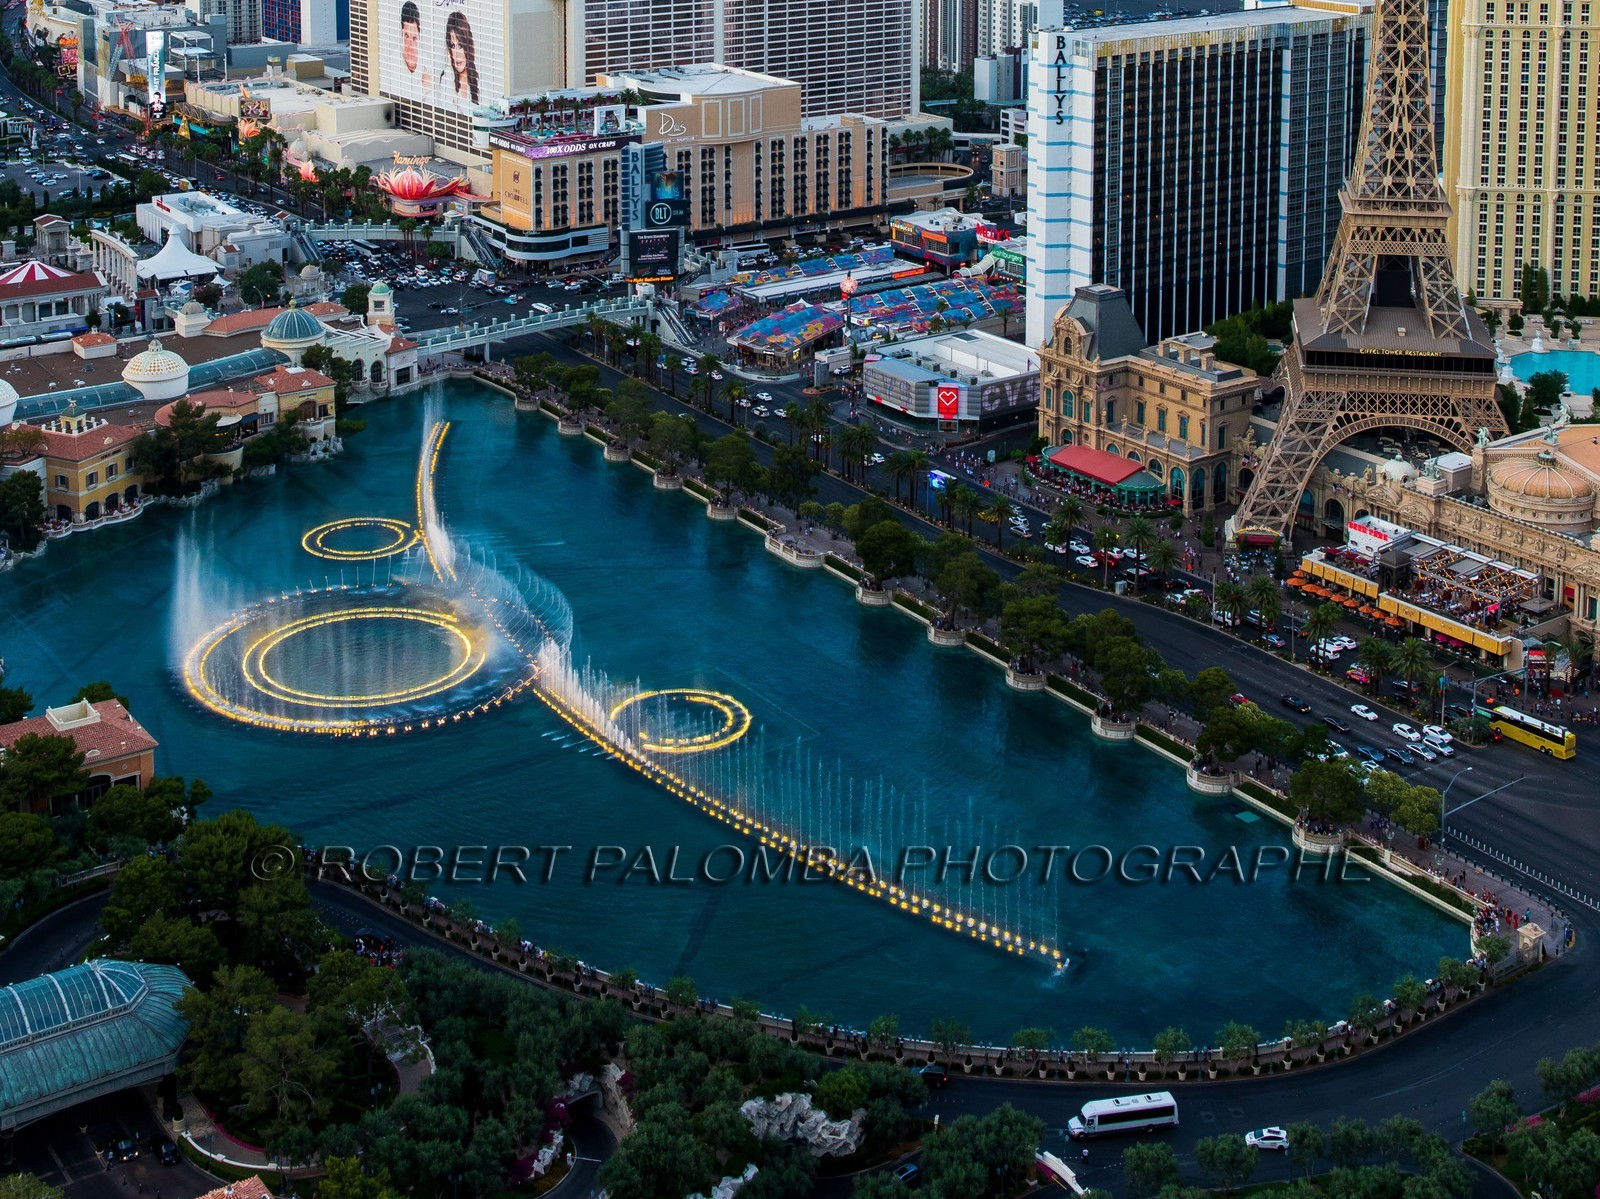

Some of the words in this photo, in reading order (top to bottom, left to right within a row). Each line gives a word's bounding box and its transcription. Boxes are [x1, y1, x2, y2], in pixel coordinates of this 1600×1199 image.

[1054, 36, 1067, 125] BALLYS
[546, 144, 563, 154] 100X
[563, 143, 587, 152] ODDS
[598, 140, 617, 148] CRAPS
[630, 152, 640, 220] BALLYS
[655, 207, 667, 220] BLT
[890, 222, 913, 233] STARBUCKS
[982, 375, 1041, 412] CVS
